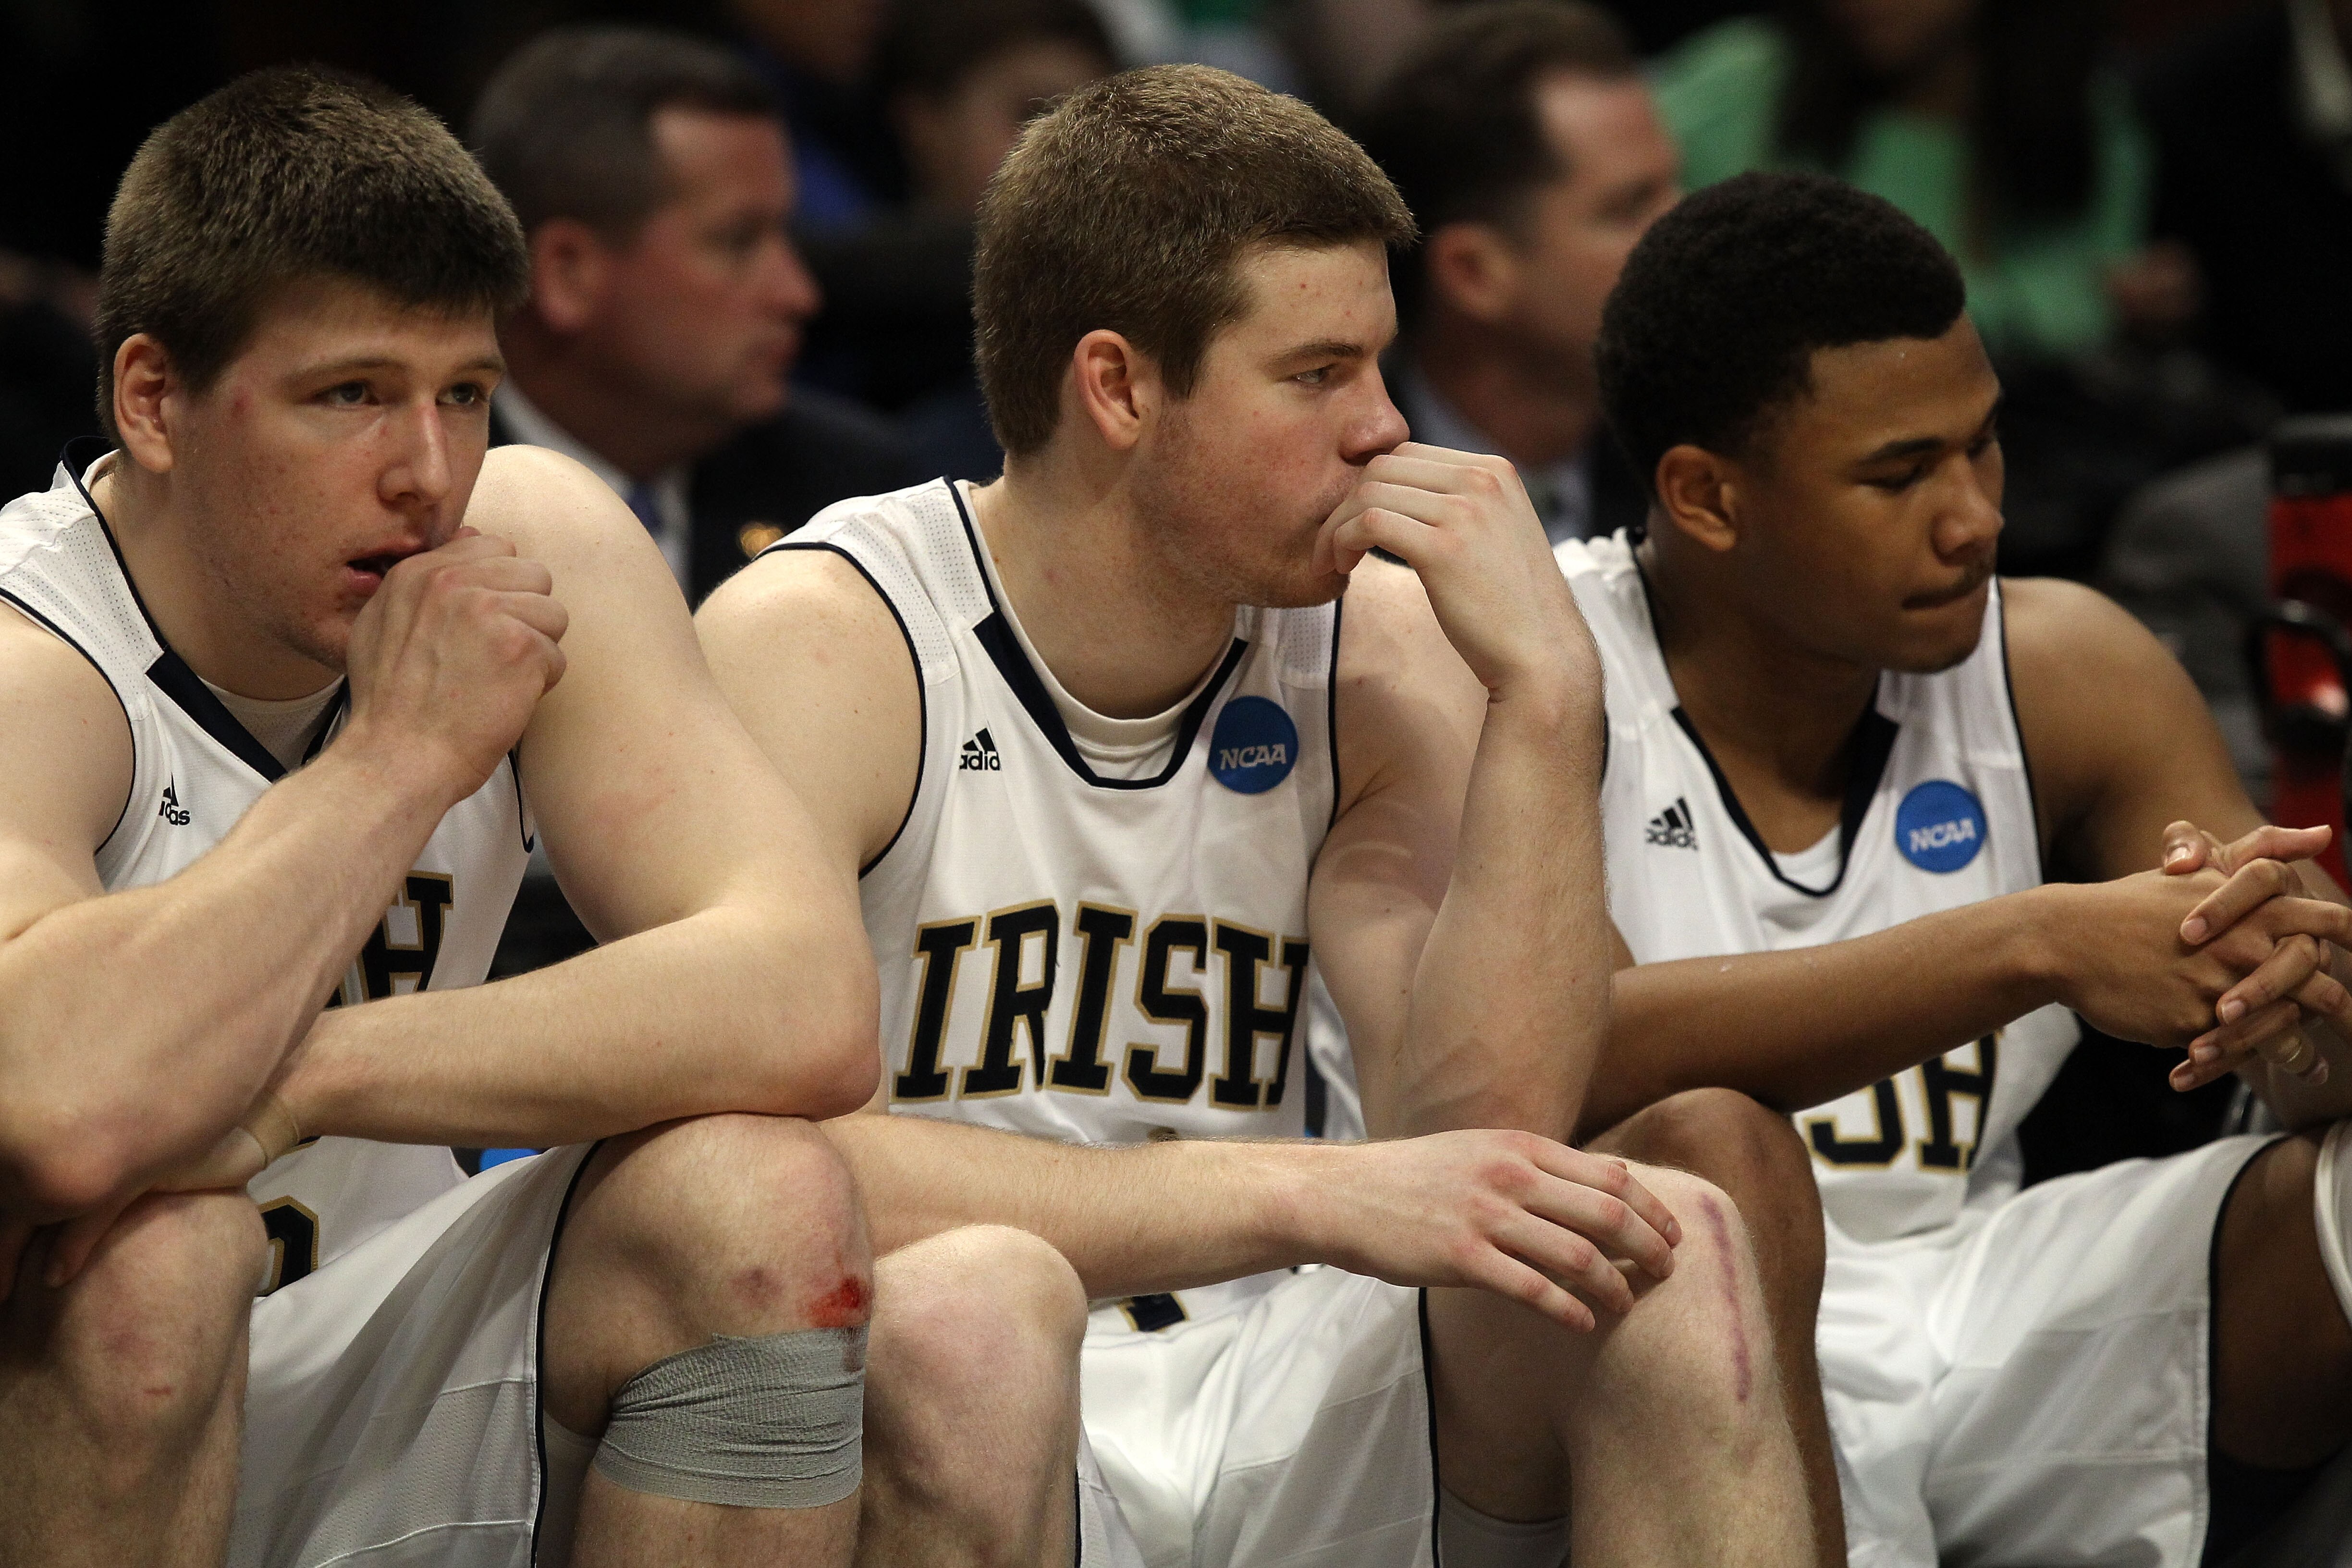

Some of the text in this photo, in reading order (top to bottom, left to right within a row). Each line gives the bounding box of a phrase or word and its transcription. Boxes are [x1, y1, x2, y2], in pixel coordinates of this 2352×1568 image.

[1219, 743, 1287, 770] NCAA
[1909, 817, 1976, 854] NCAA
[891, 897, 1310, 1112] IRISH
